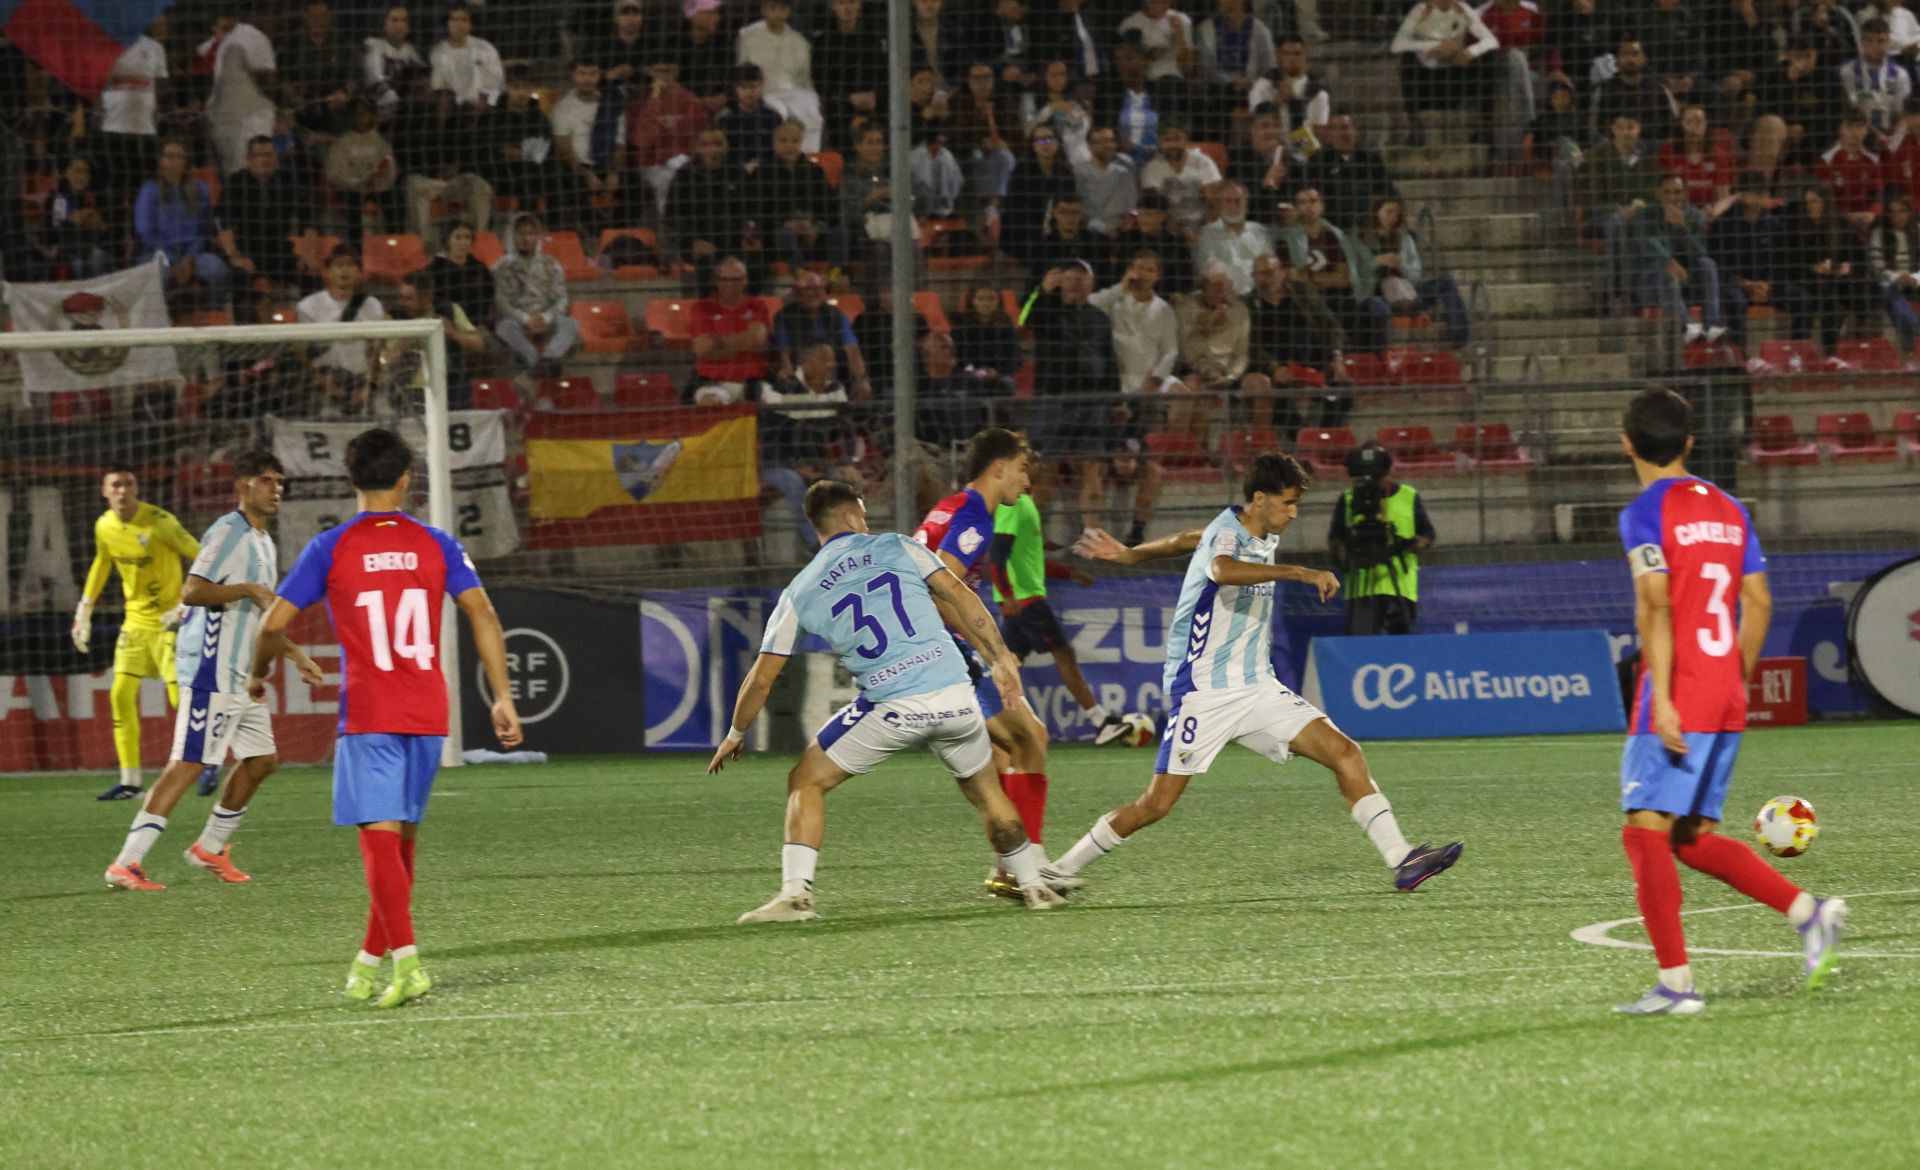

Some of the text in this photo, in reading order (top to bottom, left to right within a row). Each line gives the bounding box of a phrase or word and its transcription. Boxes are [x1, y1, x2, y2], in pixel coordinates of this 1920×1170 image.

[363, 551, 418, 573] ENEKO
[820, 554, 878, 591] RAFA R.
[1641, 545, 1660, 568] C
[830, 570, 918, 660] 37
[1696, 562, 1733, 657] 3
[353, 587, 436, 672] 14
[868, 645, 944, 687] BENAHAVIS
[1424, 670, 1592, 704] AirEuropa
[1181, 716, 1199, 745] 8
